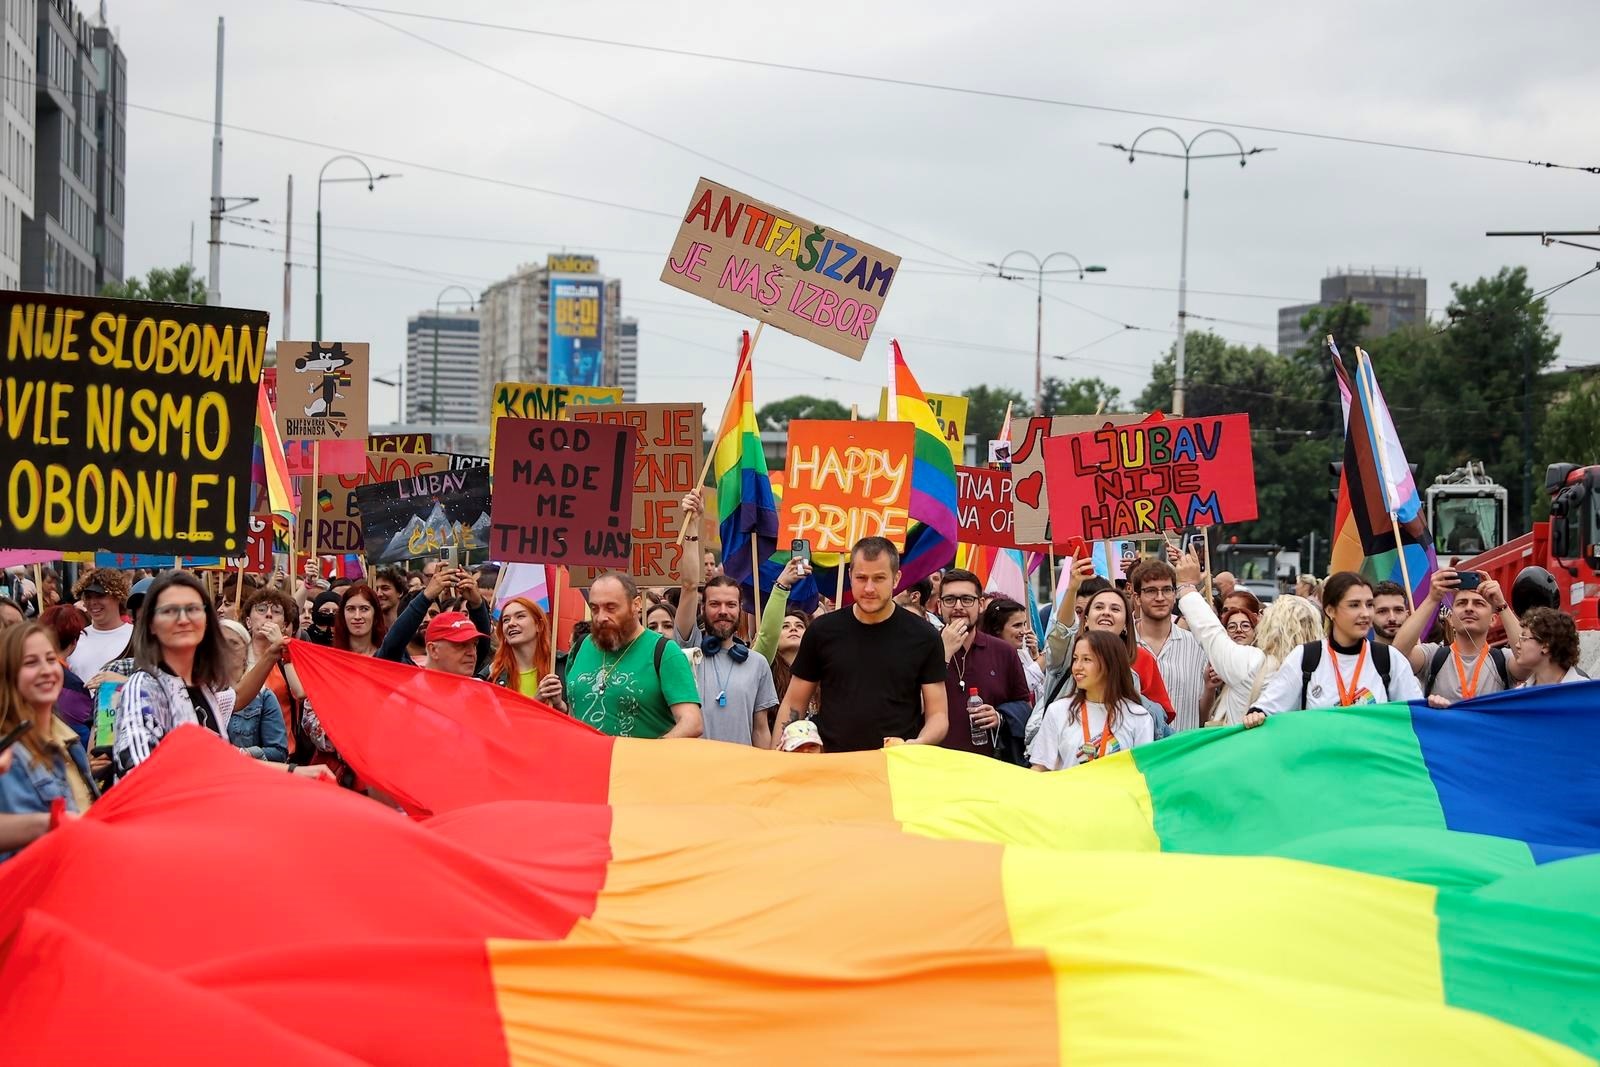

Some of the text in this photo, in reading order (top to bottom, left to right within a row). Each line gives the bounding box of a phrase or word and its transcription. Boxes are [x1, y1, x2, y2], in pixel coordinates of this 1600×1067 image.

[685, 189, 894, 297] ANTIFAŠIZAM
[670, 241, 878, 340] JE NAŠ IZBOR
[8, 303, 267, 384] NIJE SLOBODAN
[87, 384, 231, 461] NISMO
[528, 428, 590, 452] GOD
[1071, 421, 1222, 477] LJUBAV
[398, 472, 466, 499] LJUBAV
[512, 460, 600, 490] MADE
[789, 446, 908, 506] HAPPY
[1094, 463, 1201, 503] NIJE
[536, 494, 576, 518] ME
[788, 503, 909, 552] PRIDE
[1081, 490, 1223, 541] HARAM
[494, 524, 632, 559] THIS WAY
